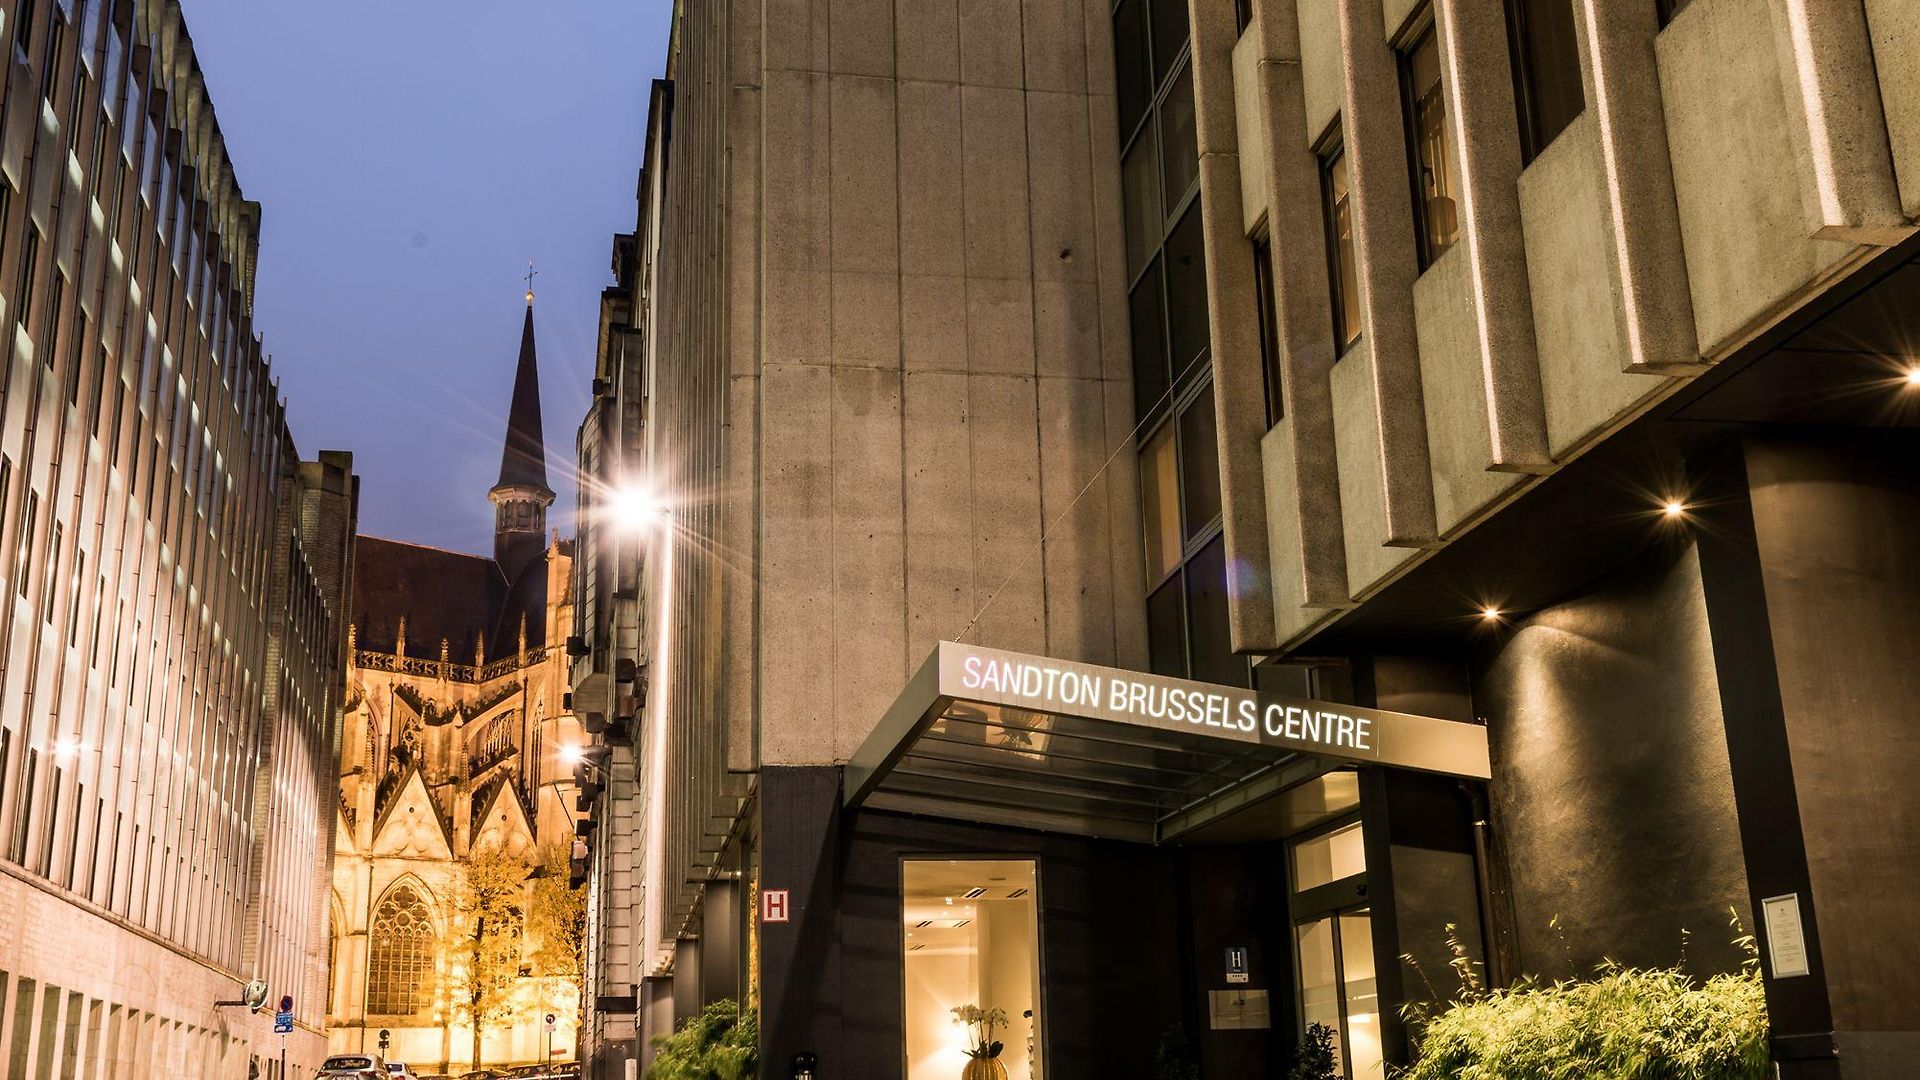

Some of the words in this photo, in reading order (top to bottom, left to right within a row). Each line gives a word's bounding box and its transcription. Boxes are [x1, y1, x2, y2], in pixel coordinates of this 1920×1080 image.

[962, 656, 1101, 708] SANDTON
[1109, 679, 1257, 732] BRUSSELS
[1265, 704, 1372, 750] CENTRE
[767, 893, 785, 918] H
[1231, 951, 1242, 968] H
